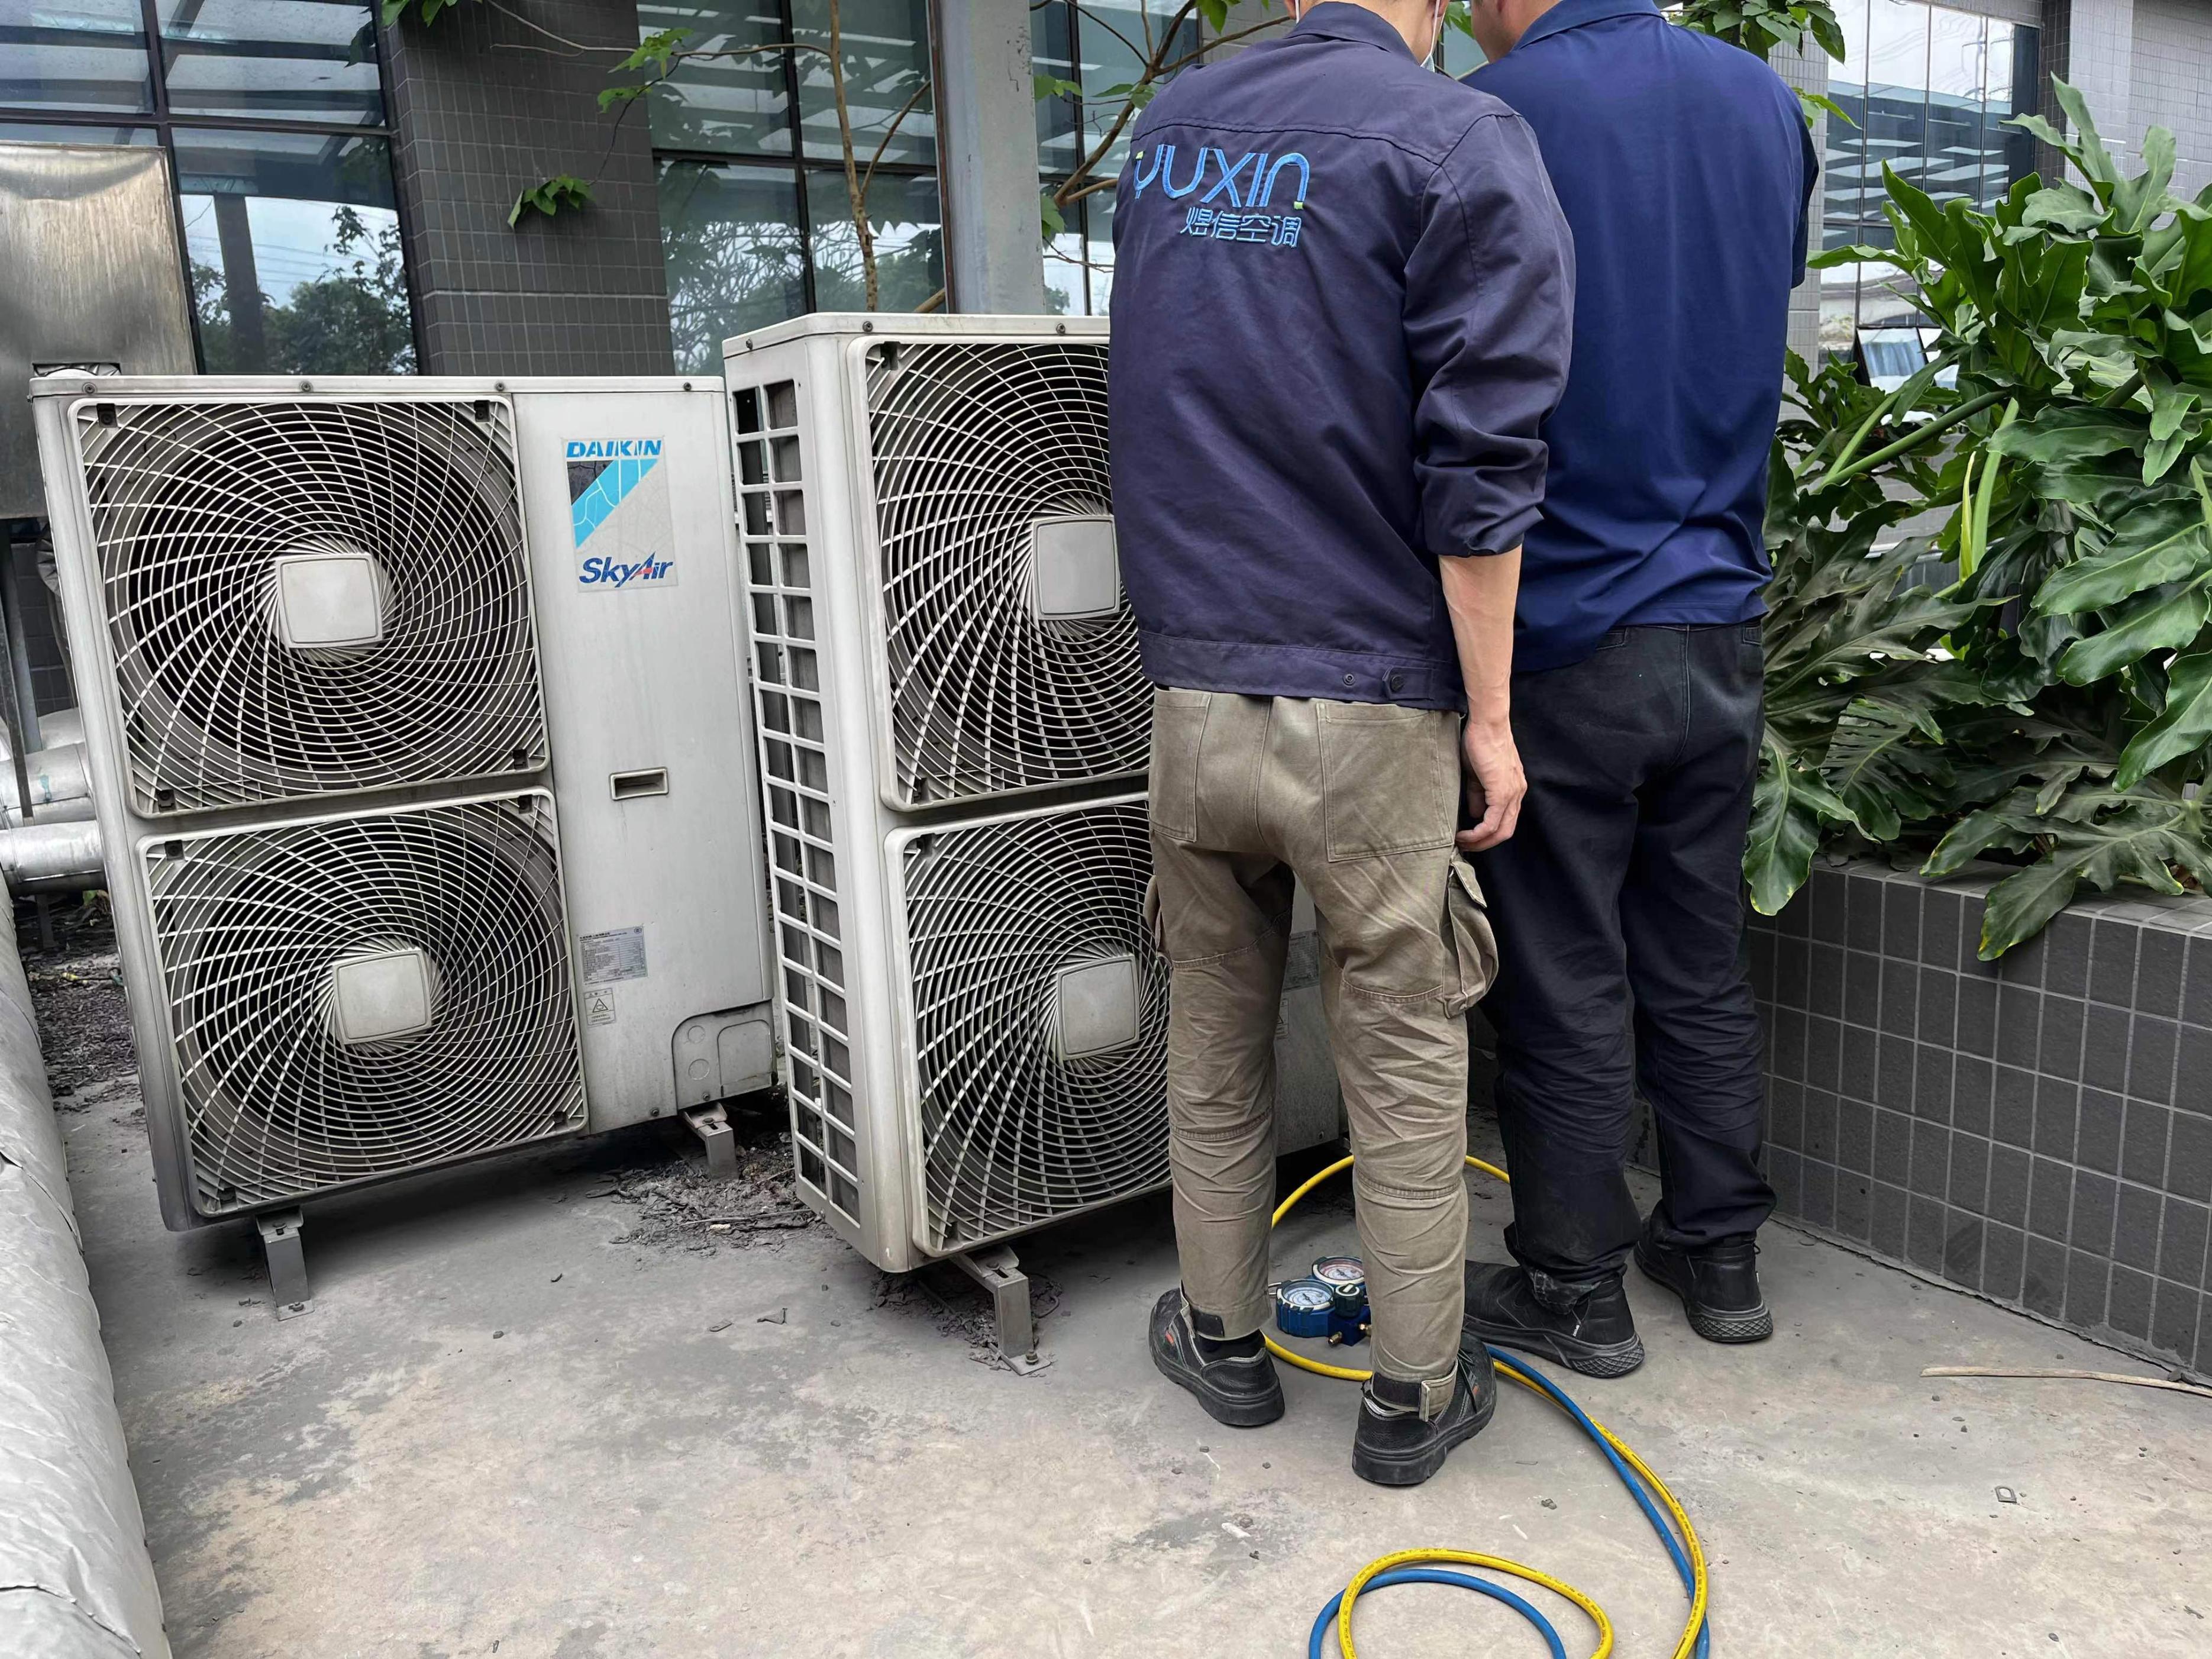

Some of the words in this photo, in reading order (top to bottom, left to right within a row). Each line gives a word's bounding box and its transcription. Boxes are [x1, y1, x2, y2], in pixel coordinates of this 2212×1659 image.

[1180, 206, 1302, 248] 煜信空调
[566, 440, 661, 458] DAIKIN
